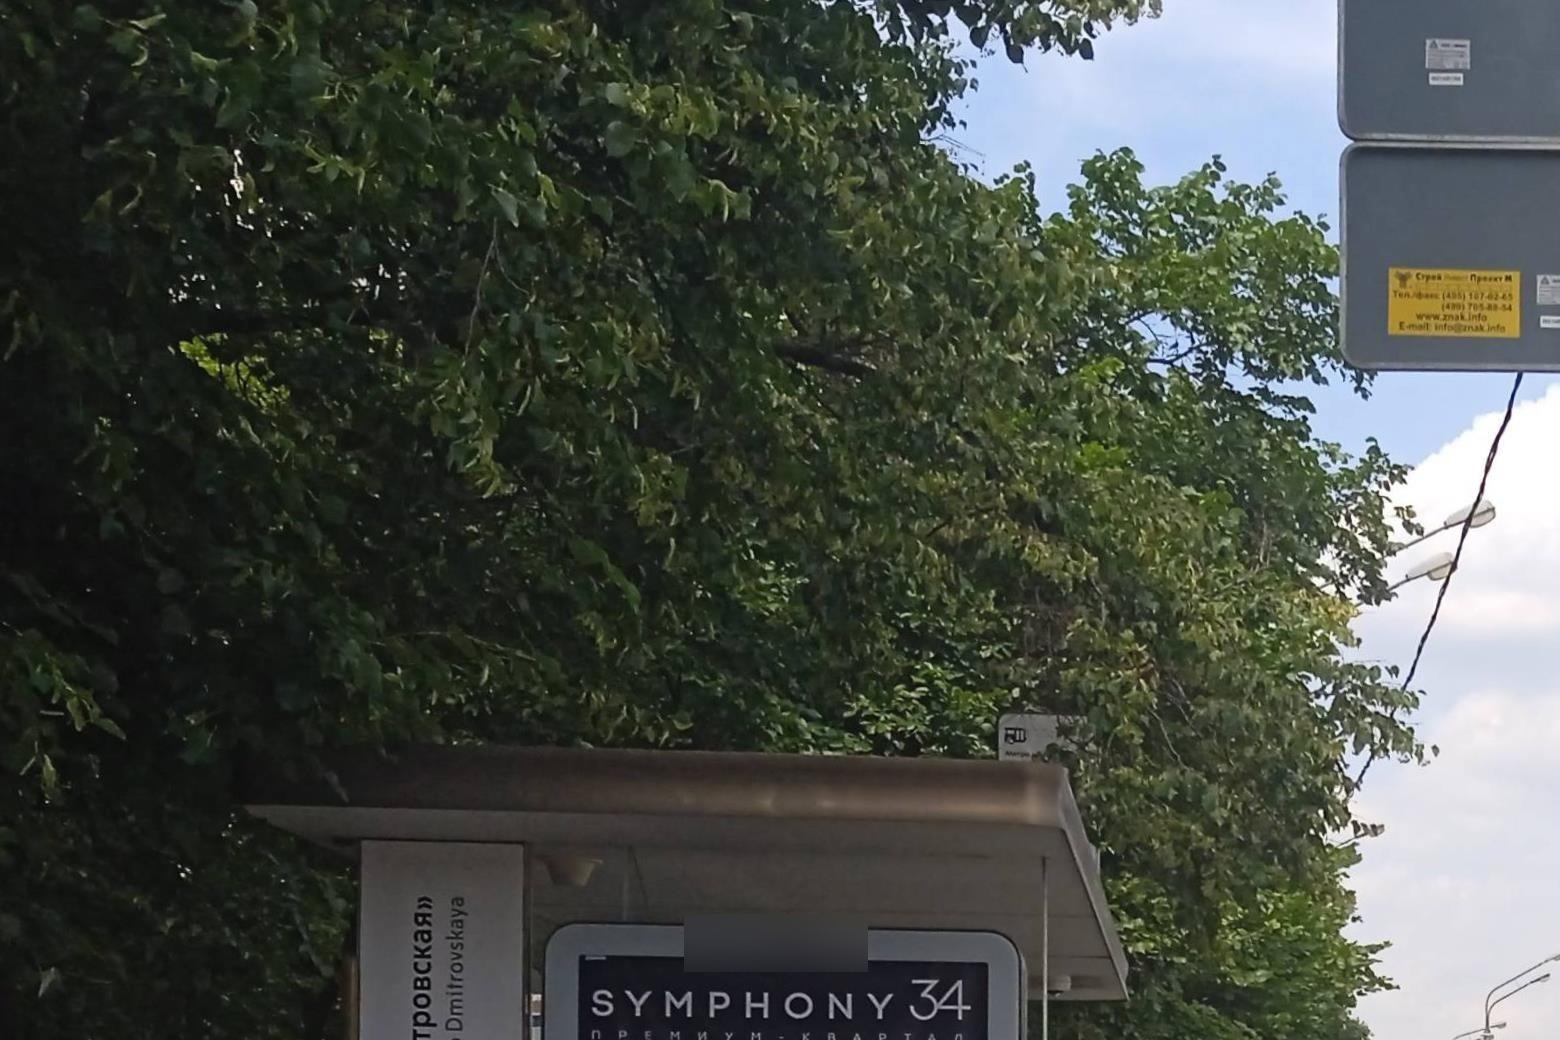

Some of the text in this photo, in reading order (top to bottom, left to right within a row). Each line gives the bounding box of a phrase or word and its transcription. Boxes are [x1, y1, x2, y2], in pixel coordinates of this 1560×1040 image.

[444, 896, 468, 1032] Dmitrovskaya
[591, 978, 972, 1021] SYMPHONY 34
